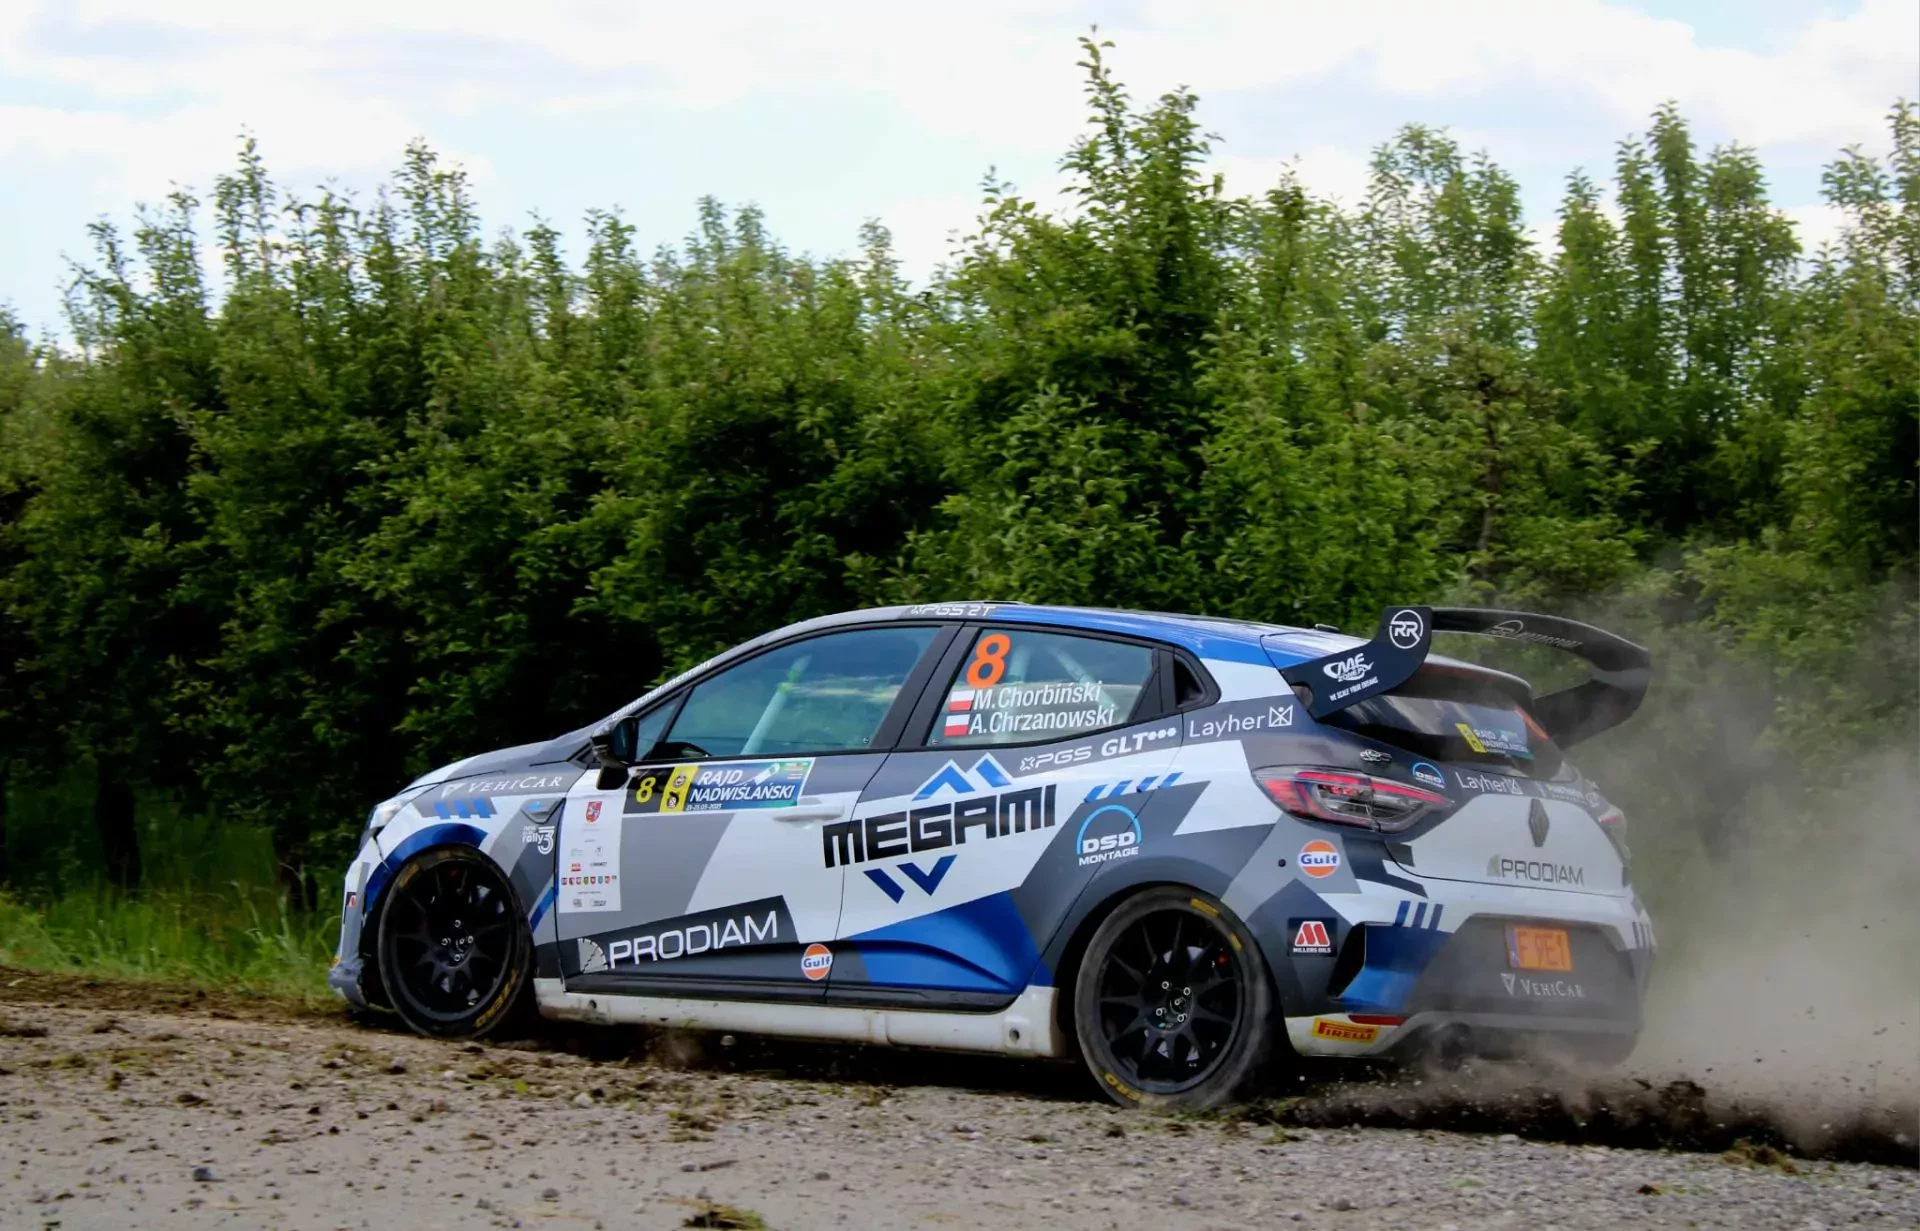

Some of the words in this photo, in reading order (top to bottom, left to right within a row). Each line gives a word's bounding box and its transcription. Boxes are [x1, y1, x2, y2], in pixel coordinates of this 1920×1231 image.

[965, 633, 1012, 689] 8
[1189, 713, 1266, 738] Layher
[697, 769, 744, 787] RAJD
[1455, 771, 1505, 792] Layher
[635, 776, 656, 804] 8
[689, 783, 796, 803] NADWIŚLAŃSKI
[823, 783, 1058, 869] MEGAMI
[1082, 831, 1136, 854] DSD
[1078, 846, 1140, 867] MONTAGE
[1300, 853, 1339, 865] Gulf
[1501, 858, 1585, 887] PRODIAM
[609, 910, 779, 970] PRODIAM
[803, 956, 832, 968] Gulf
[1317, 1021, 1376, 1040] PIRELLI
